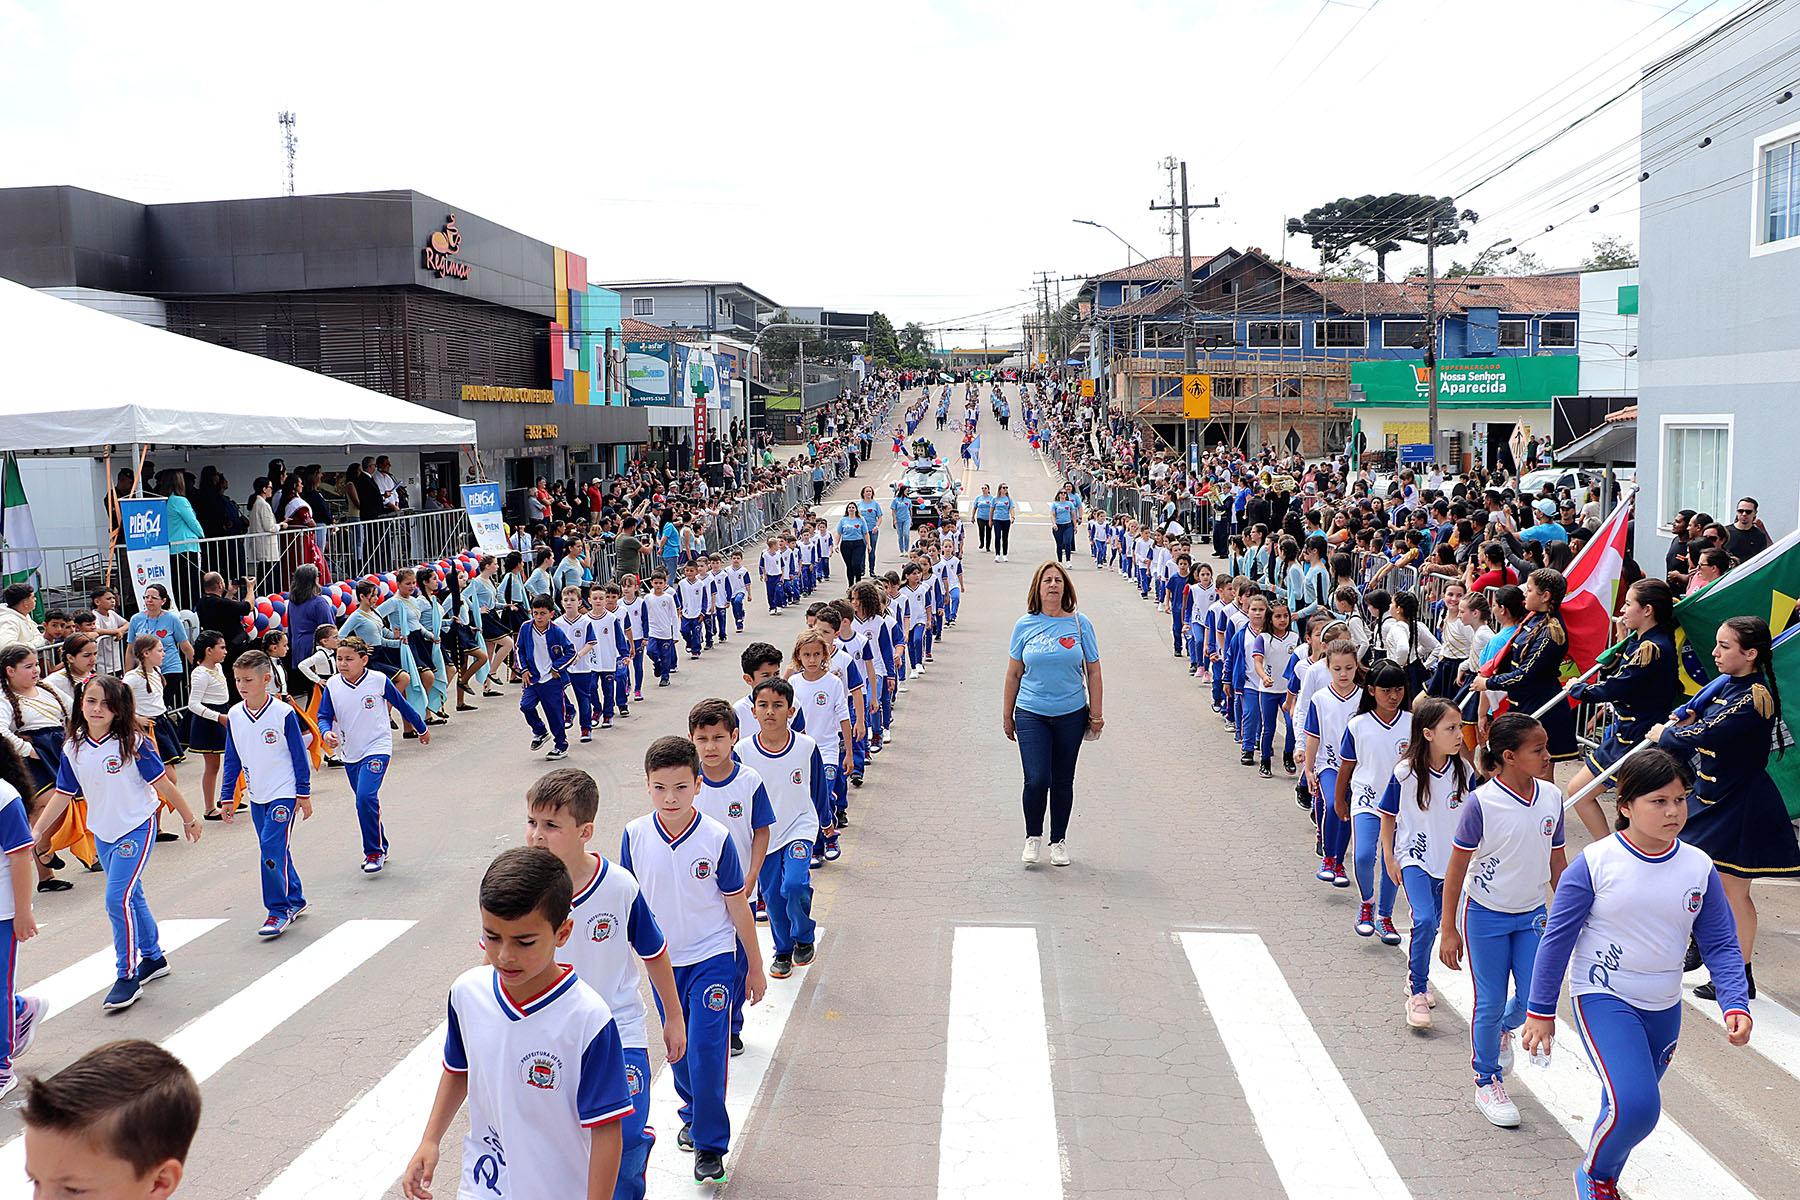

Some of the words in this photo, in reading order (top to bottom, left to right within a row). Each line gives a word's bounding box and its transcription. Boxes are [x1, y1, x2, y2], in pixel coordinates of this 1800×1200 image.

[425, 247, 472, 279] Regimar
[1440, 371, 1466, 381] Nossa
[1468, 371, 1506, 384] Senhora
[1440, 381, 1507, 396] Aparecida
[481, 490, 495, 506] 64
[145, 509, 161, 537] 64
[1588, 943, 1624, 992] Piên
[521, 1050, 550, 1064] PREFEITURA
